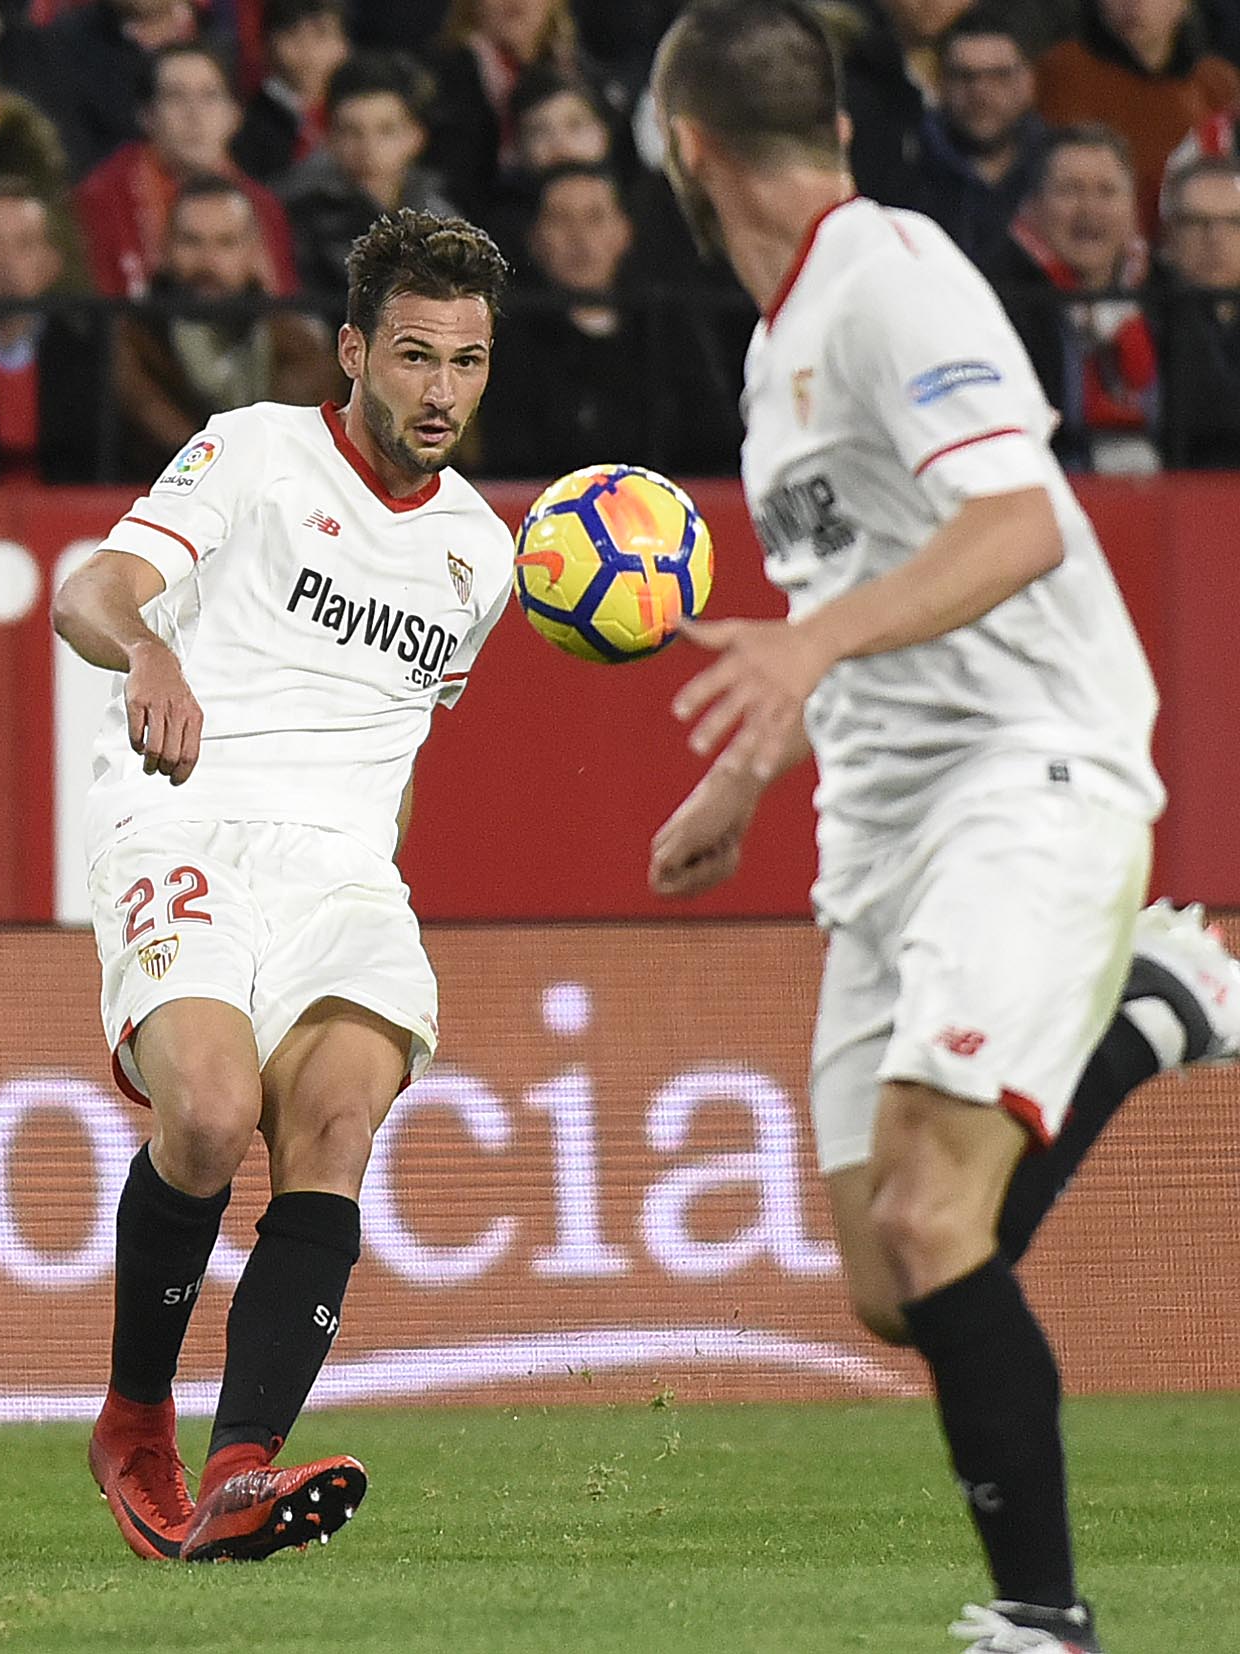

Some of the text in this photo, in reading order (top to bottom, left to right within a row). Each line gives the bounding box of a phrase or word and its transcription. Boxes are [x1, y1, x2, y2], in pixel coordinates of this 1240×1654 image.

[159, 475, 195, 487] LaLiga
[286, 567, 458, 678] PlayWSOP
[115, 866, 213, 950] 22
